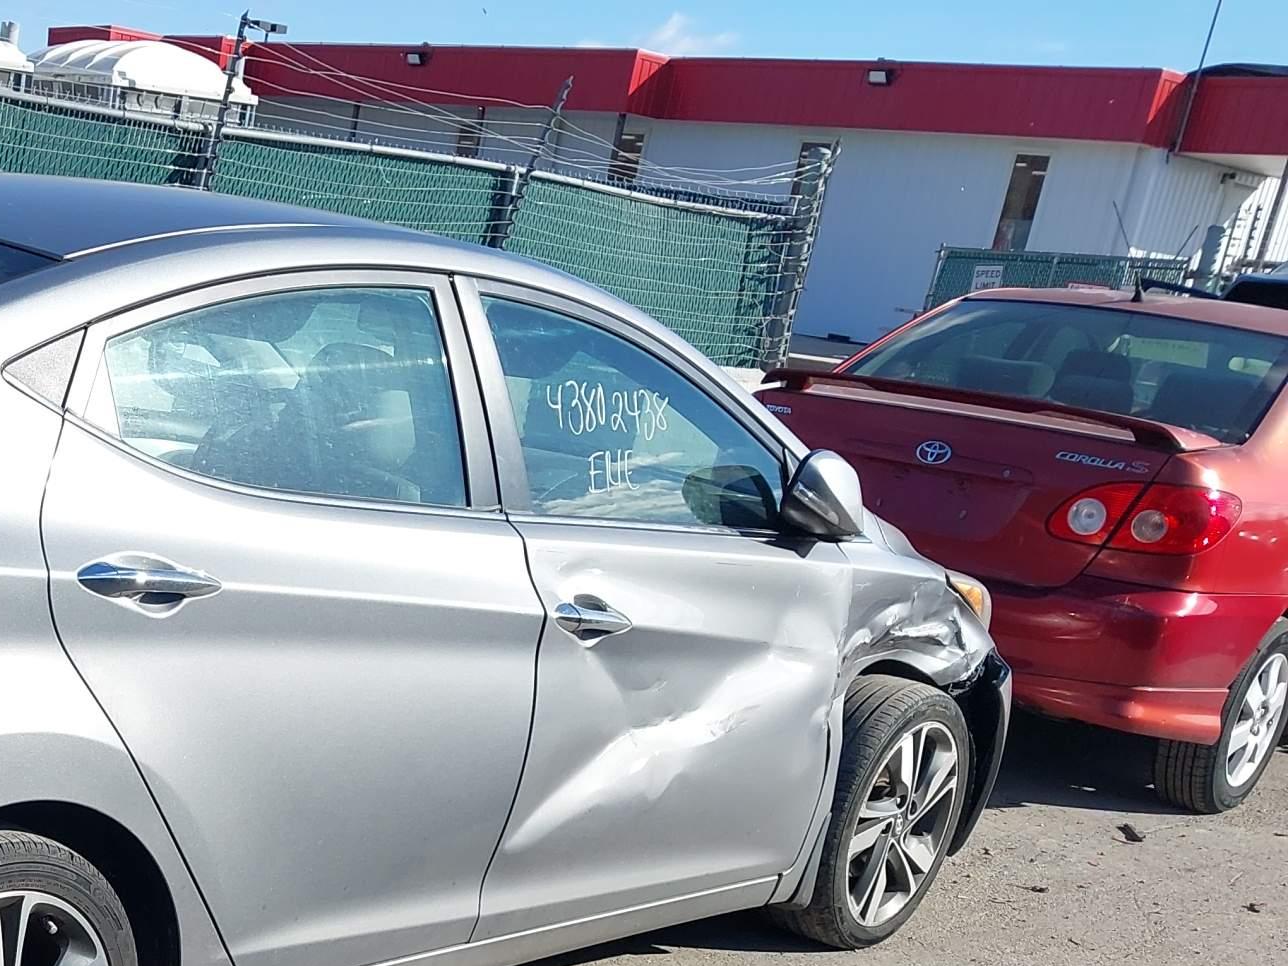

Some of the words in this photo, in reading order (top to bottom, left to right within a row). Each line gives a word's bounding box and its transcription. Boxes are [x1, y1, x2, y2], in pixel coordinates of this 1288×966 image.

[975, 270, 1001, 278] SPEED
[546, 380, 669, 440] 43802438
[1055, 451, 1126, 470] COROLLA
[1126, 461, 1151, 474] S
